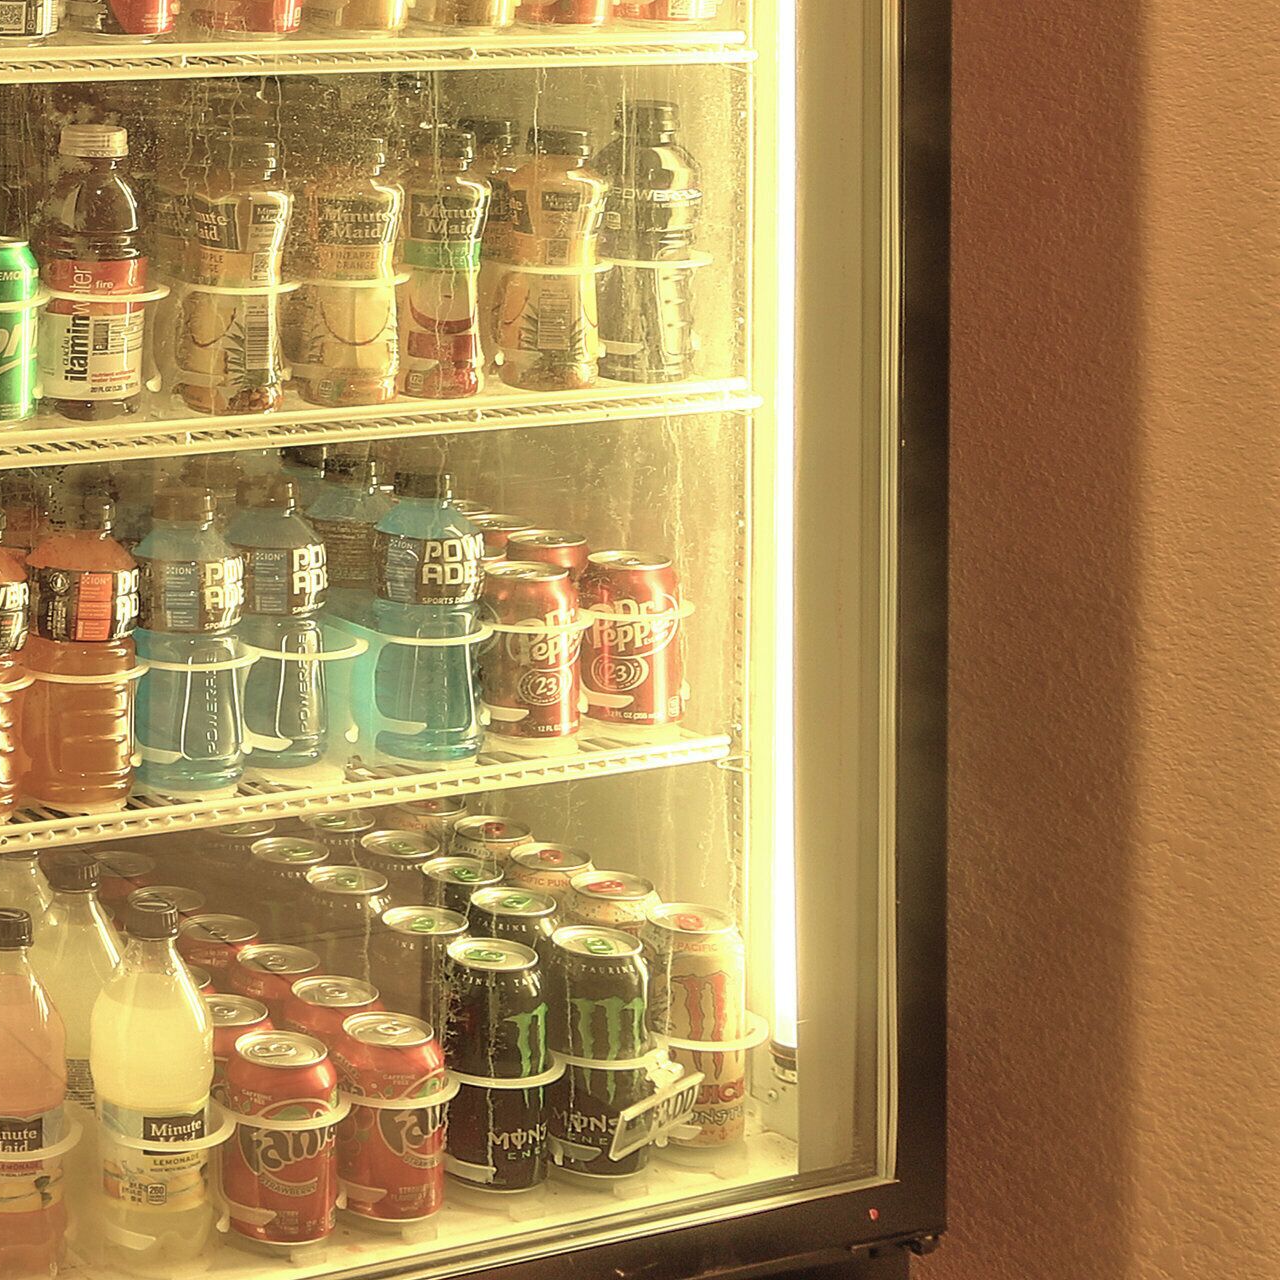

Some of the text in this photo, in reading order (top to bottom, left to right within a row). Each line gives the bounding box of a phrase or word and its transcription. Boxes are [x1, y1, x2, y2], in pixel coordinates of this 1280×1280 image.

[332, 223, 381, 240] Maid
[428, 219, 477, 236] Maid
[96, 281, 114, 289] fire
[422, 596, 455, 605] SPORTS
[536, 677, 558, 695] 23
[676, 942, 719, 952] PACIFIC
[382, 1073, 416, 1082] CAFFEINE
[241, 1089, 273, 1102] CAFFEINE
[248, 1098, 266, 1106] FREE
[151, 1120, 202, 1137] Minute
[153, 1153, 200, 1167] LEMONADE
[149, 1186, 165, 1197] 260
